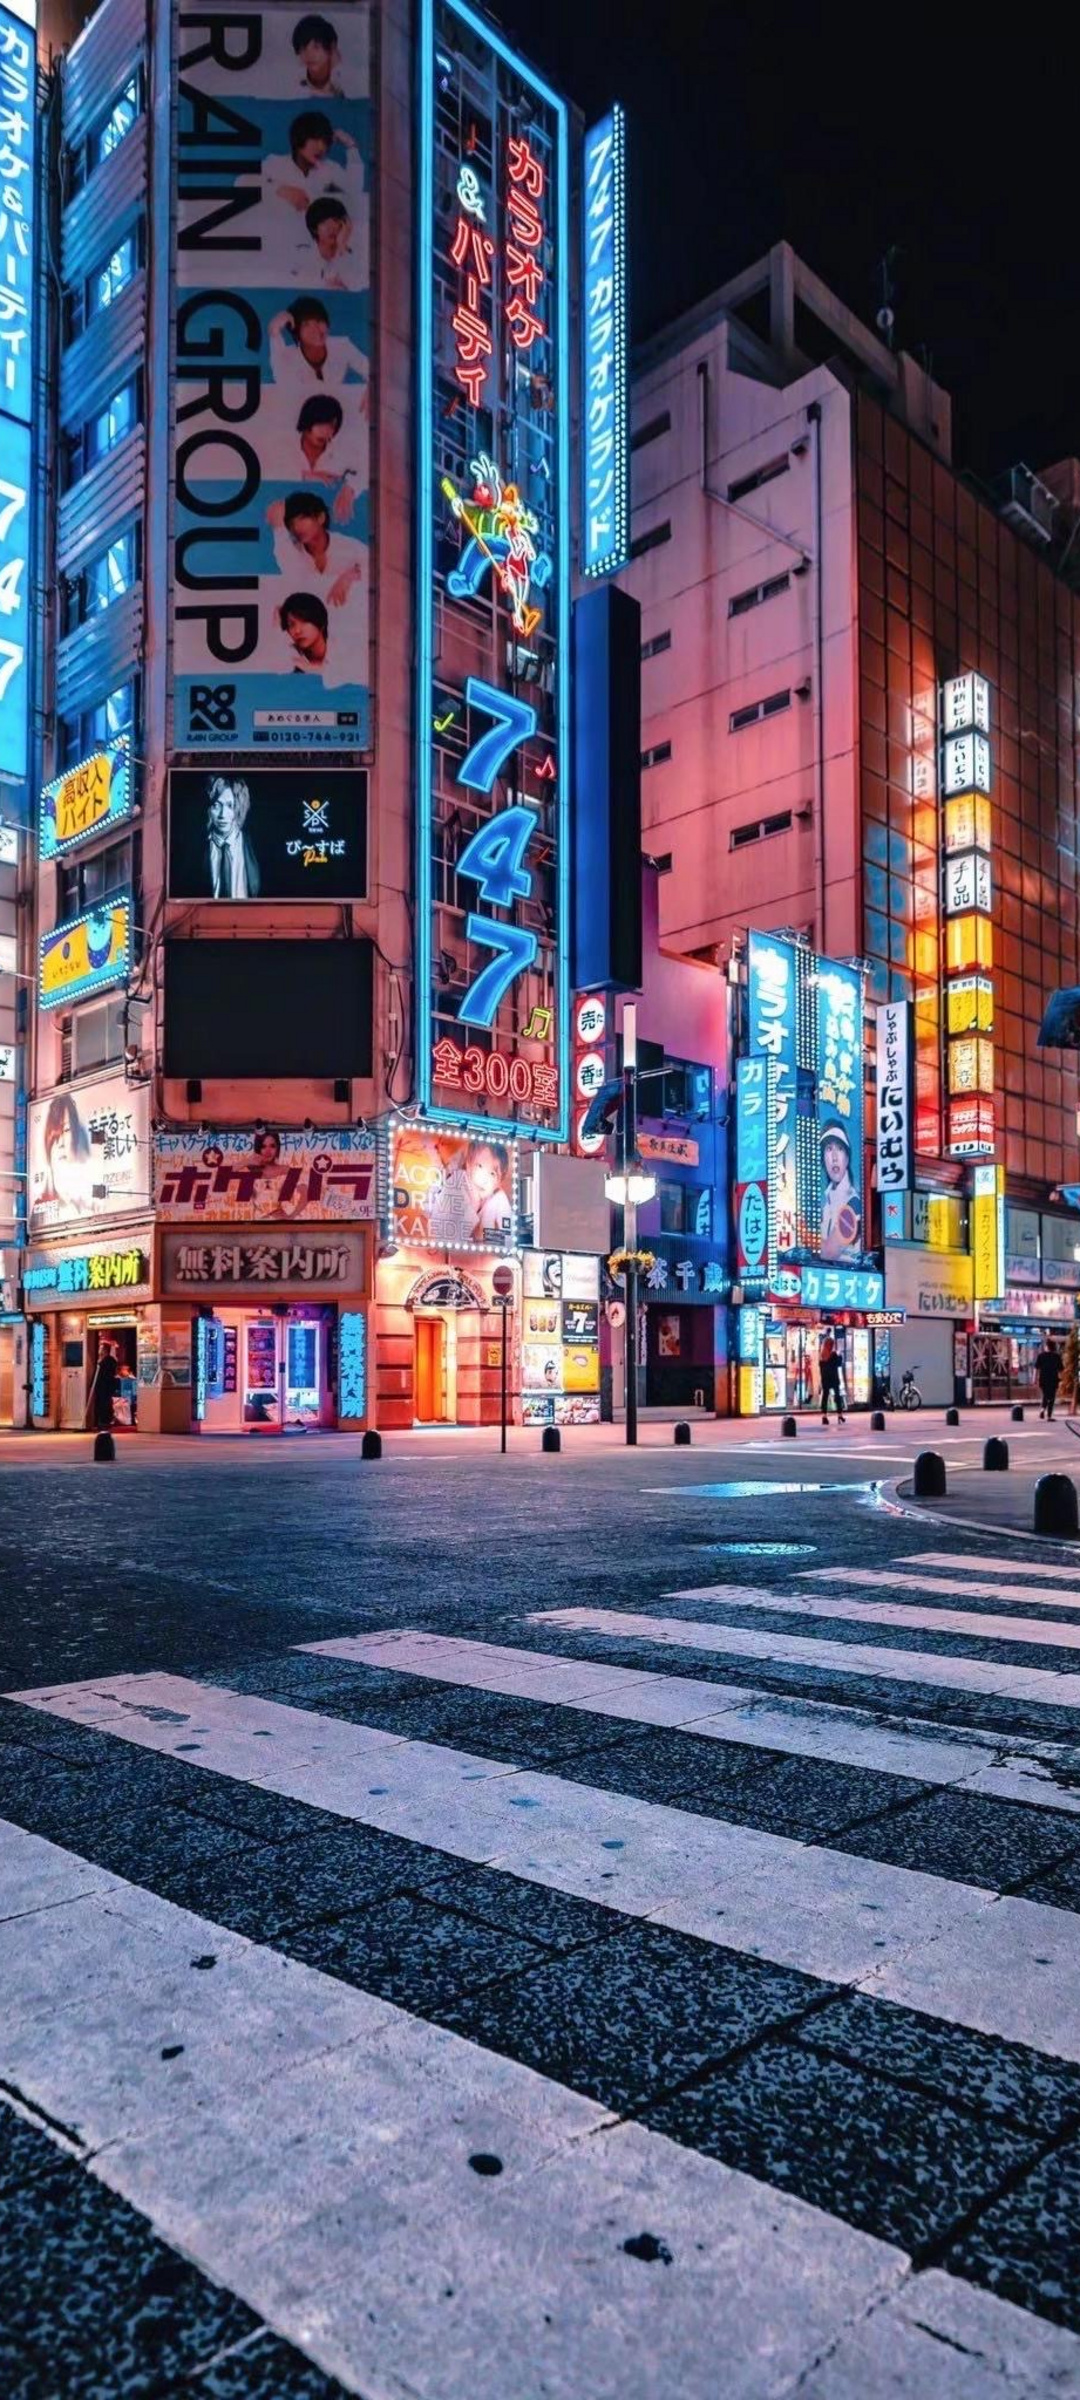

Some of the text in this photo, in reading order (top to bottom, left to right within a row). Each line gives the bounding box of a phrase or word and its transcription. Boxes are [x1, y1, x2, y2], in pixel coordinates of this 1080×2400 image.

[589, 134, 613, 267] 747
[506, 138, 544, 348] カラオケ
[175, 14, 262, 664] RAIN GROUP
[186, 733, 239, 742] RAIN GROUP
[63, 763, 103, 809] 高収入
[456, 676, 538, 1028] 747
[432, 1040, 560, 1108] 全300室
[879, 1008, 905, 1185] しゃぶしゃぶ にいむら
[742, 1061, 765, 1179] カラオケ
[160, 1147, 374, 1204] ポケパラ
[393, 1187, 464, 1217] DRIVE
[393, 1213, 473, 1241] KAEDE
[58, 1250, 140, 1292] 無料案内所
[177, 1245, 350, 1282] 無料案内所
[805, 1271, 884, 1305] カラオケ
[918, 1291, 968, 1313] にいむら
[573, 1310, 589, 1334] 7
